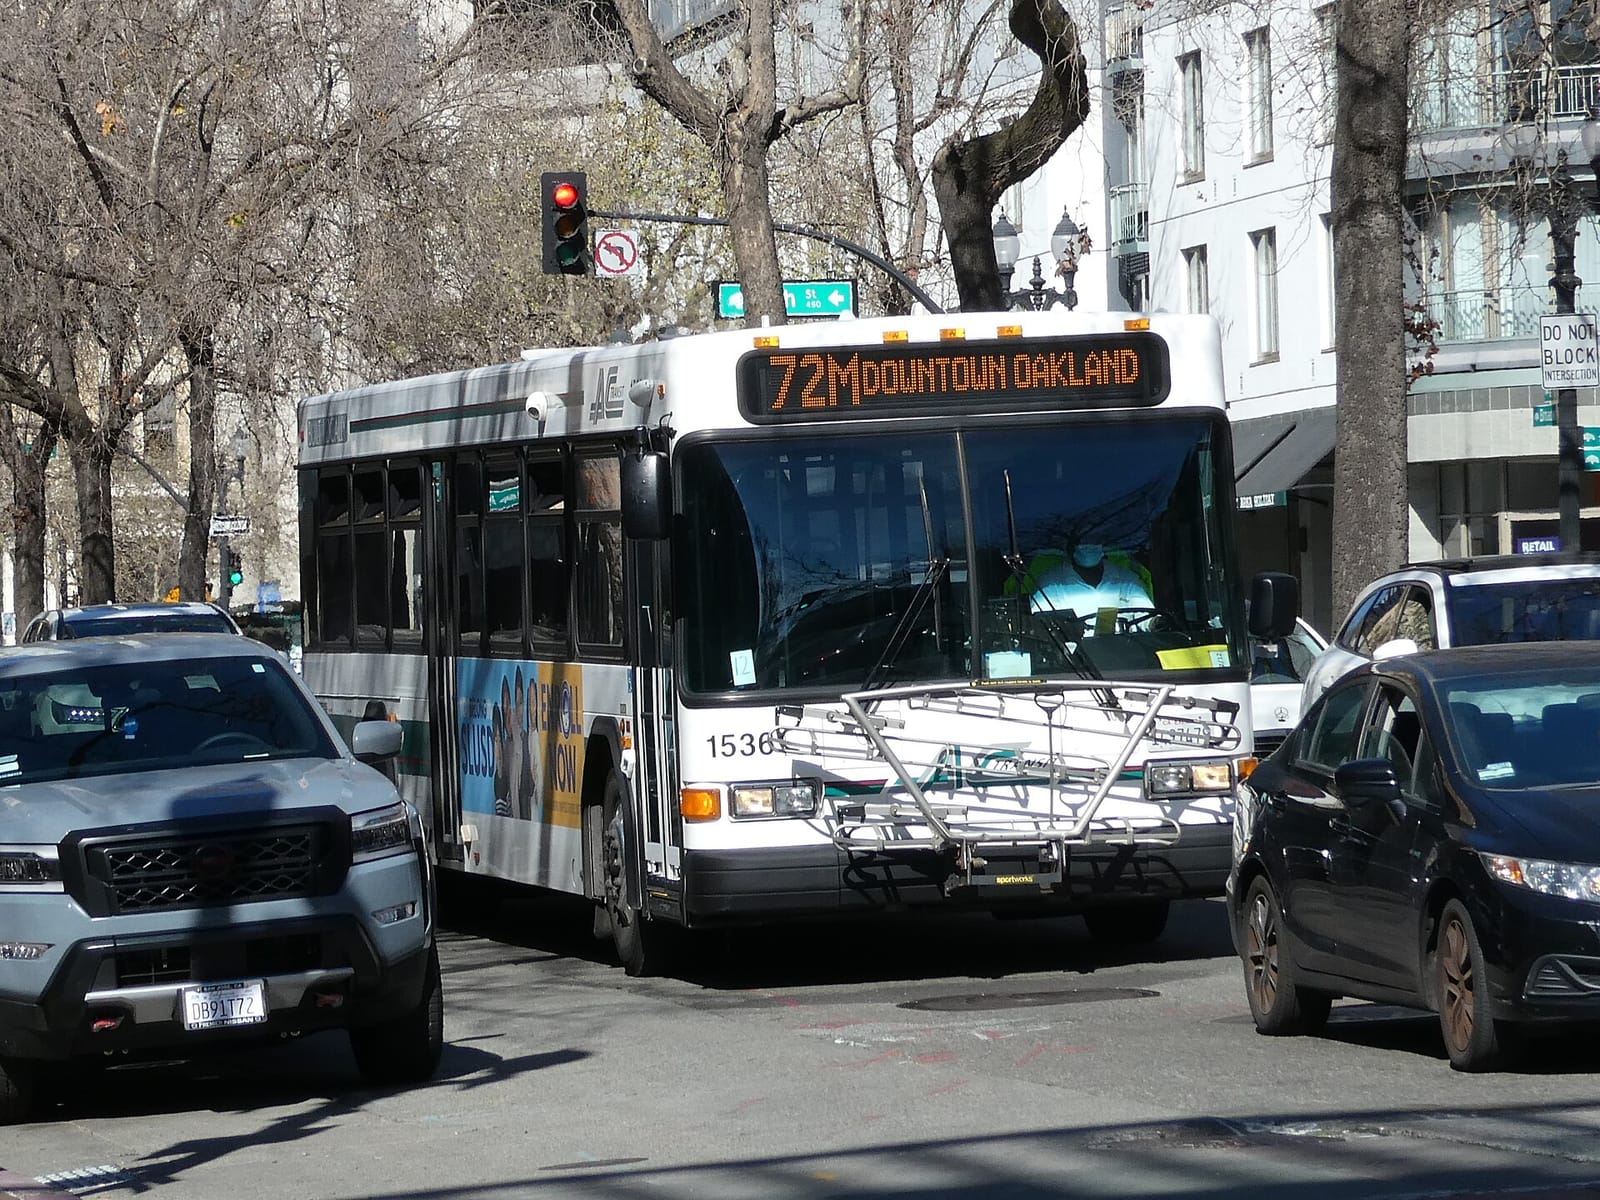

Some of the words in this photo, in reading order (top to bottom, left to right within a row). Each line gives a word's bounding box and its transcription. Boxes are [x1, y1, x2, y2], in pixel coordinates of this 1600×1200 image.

[805, 289, 817, 299] St
[1543, 325, 1561, 341] DO
[1568, 323, 1594, 340] NOT
[1544, 347, 1595, 365] BLOCK
[769, 352, 861, 409] 72M
[862, 355, 1007, 396] DOWNTOWN
[1013, 349, 1139, 389] OAKLAND
[1545, 368, 1597, 381] INTERSECTION
[1522, 540, 1555, 552] RETAIL
[461, 723, 495, 778] SLUSD
[706, 732, 773, 759] 1536
[549, 743, 577, 794] NOW
[996, 875, 1034, 884] sportworks
[192, 997, 255, 1021] DB91T72
[223, 1016, 254, 1025] NISSAN
